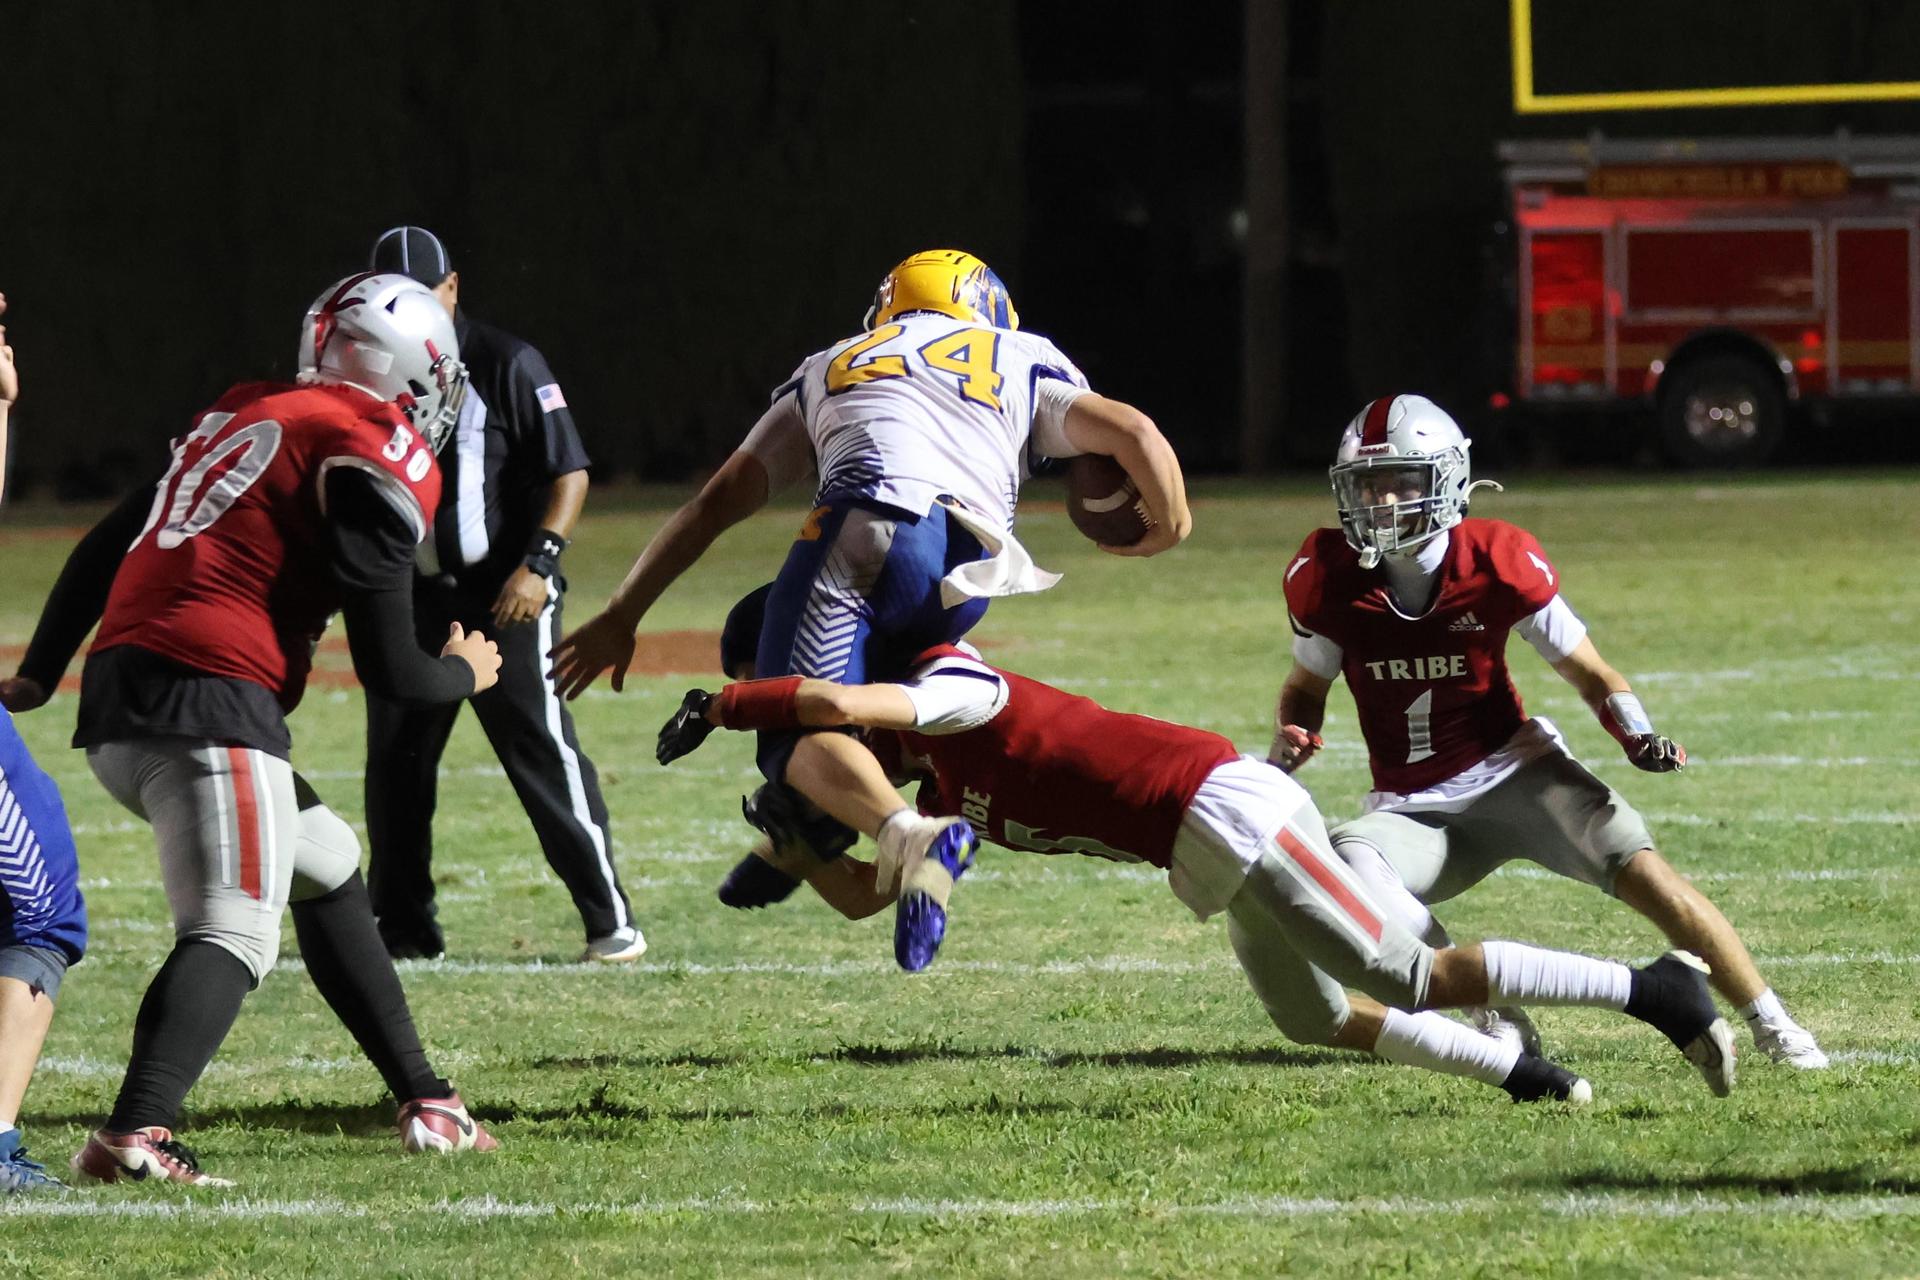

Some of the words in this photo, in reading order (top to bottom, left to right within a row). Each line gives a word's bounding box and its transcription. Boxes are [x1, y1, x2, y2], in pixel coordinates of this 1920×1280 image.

[825, 325, 1004, 414] 24
[382, 424, 432, 482] 50
[1365, 656, 1467, 680] TRIBE
[1404, 688, 1437, 764] 1
